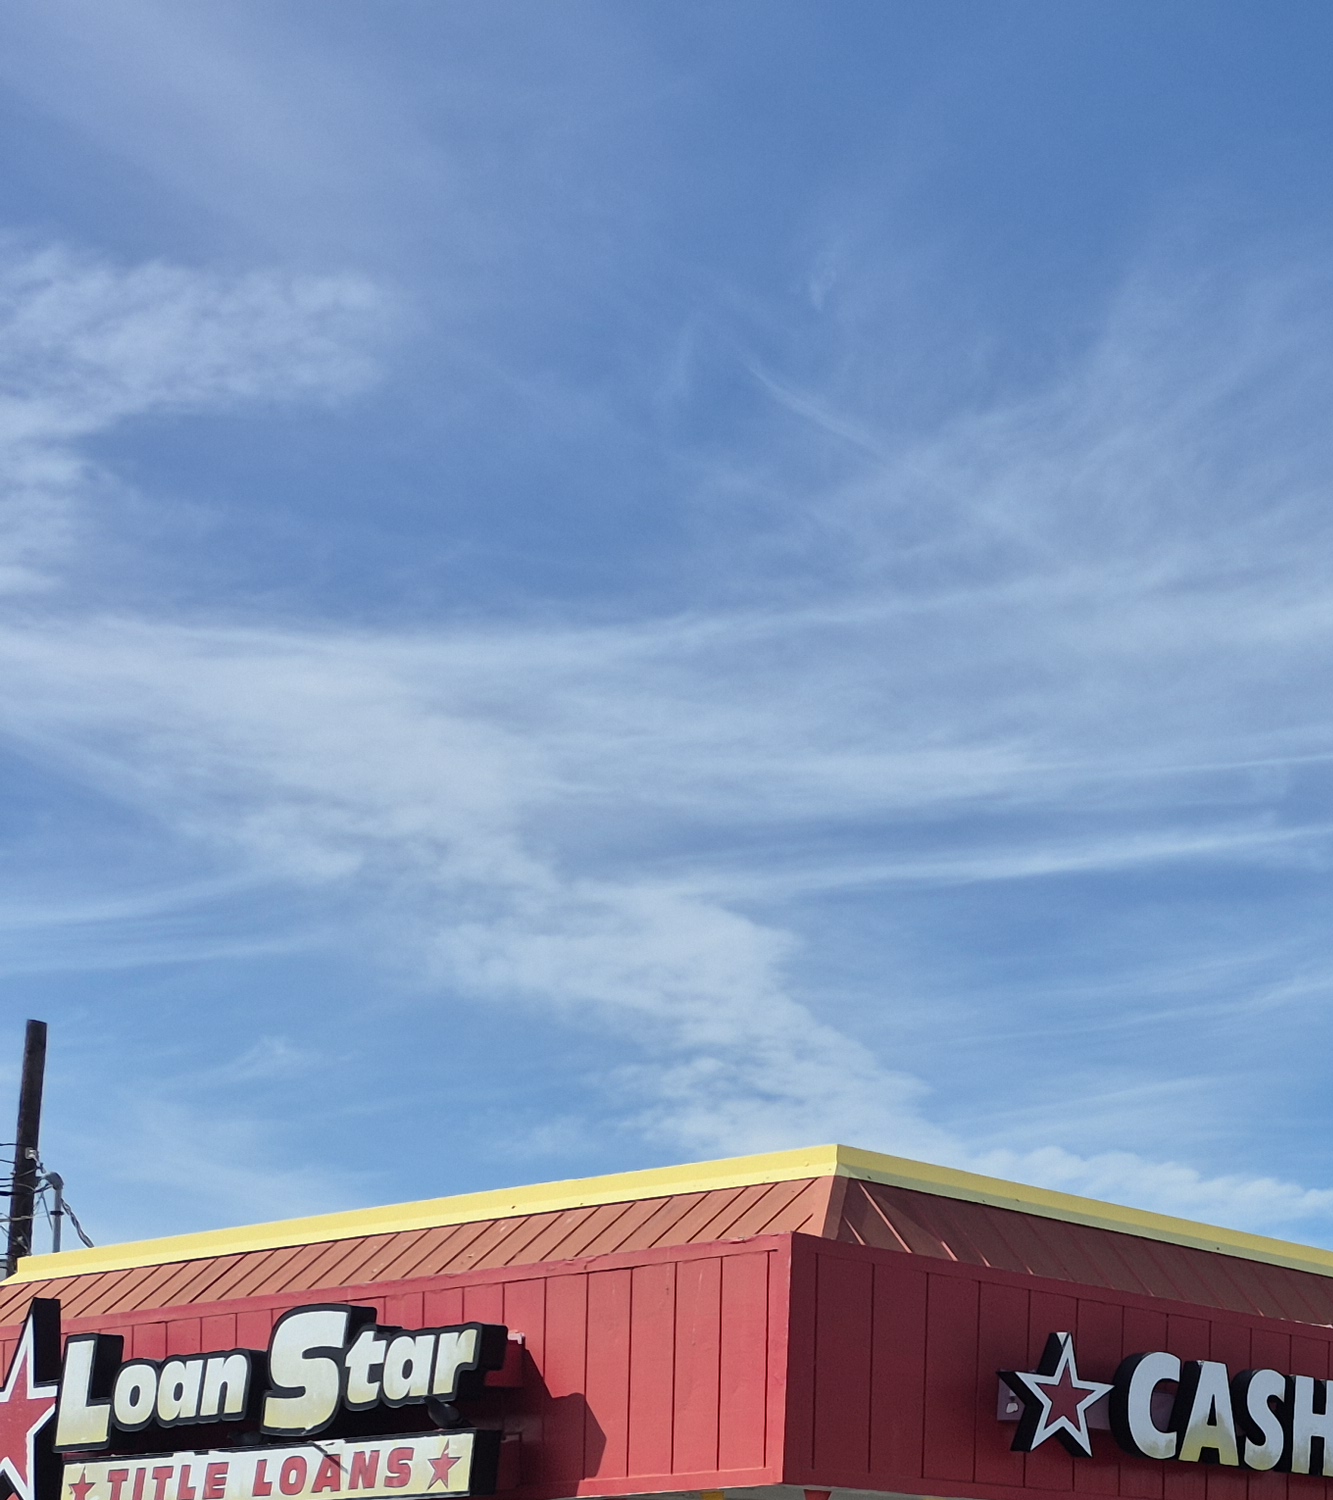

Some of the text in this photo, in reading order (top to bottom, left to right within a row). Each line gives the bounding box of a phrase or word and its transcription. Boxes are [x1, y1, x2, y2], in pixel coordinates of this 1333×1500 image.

[55, 1310, 479, 1449] Loan Star
[251, 1447, 416, 1498] LOANS
